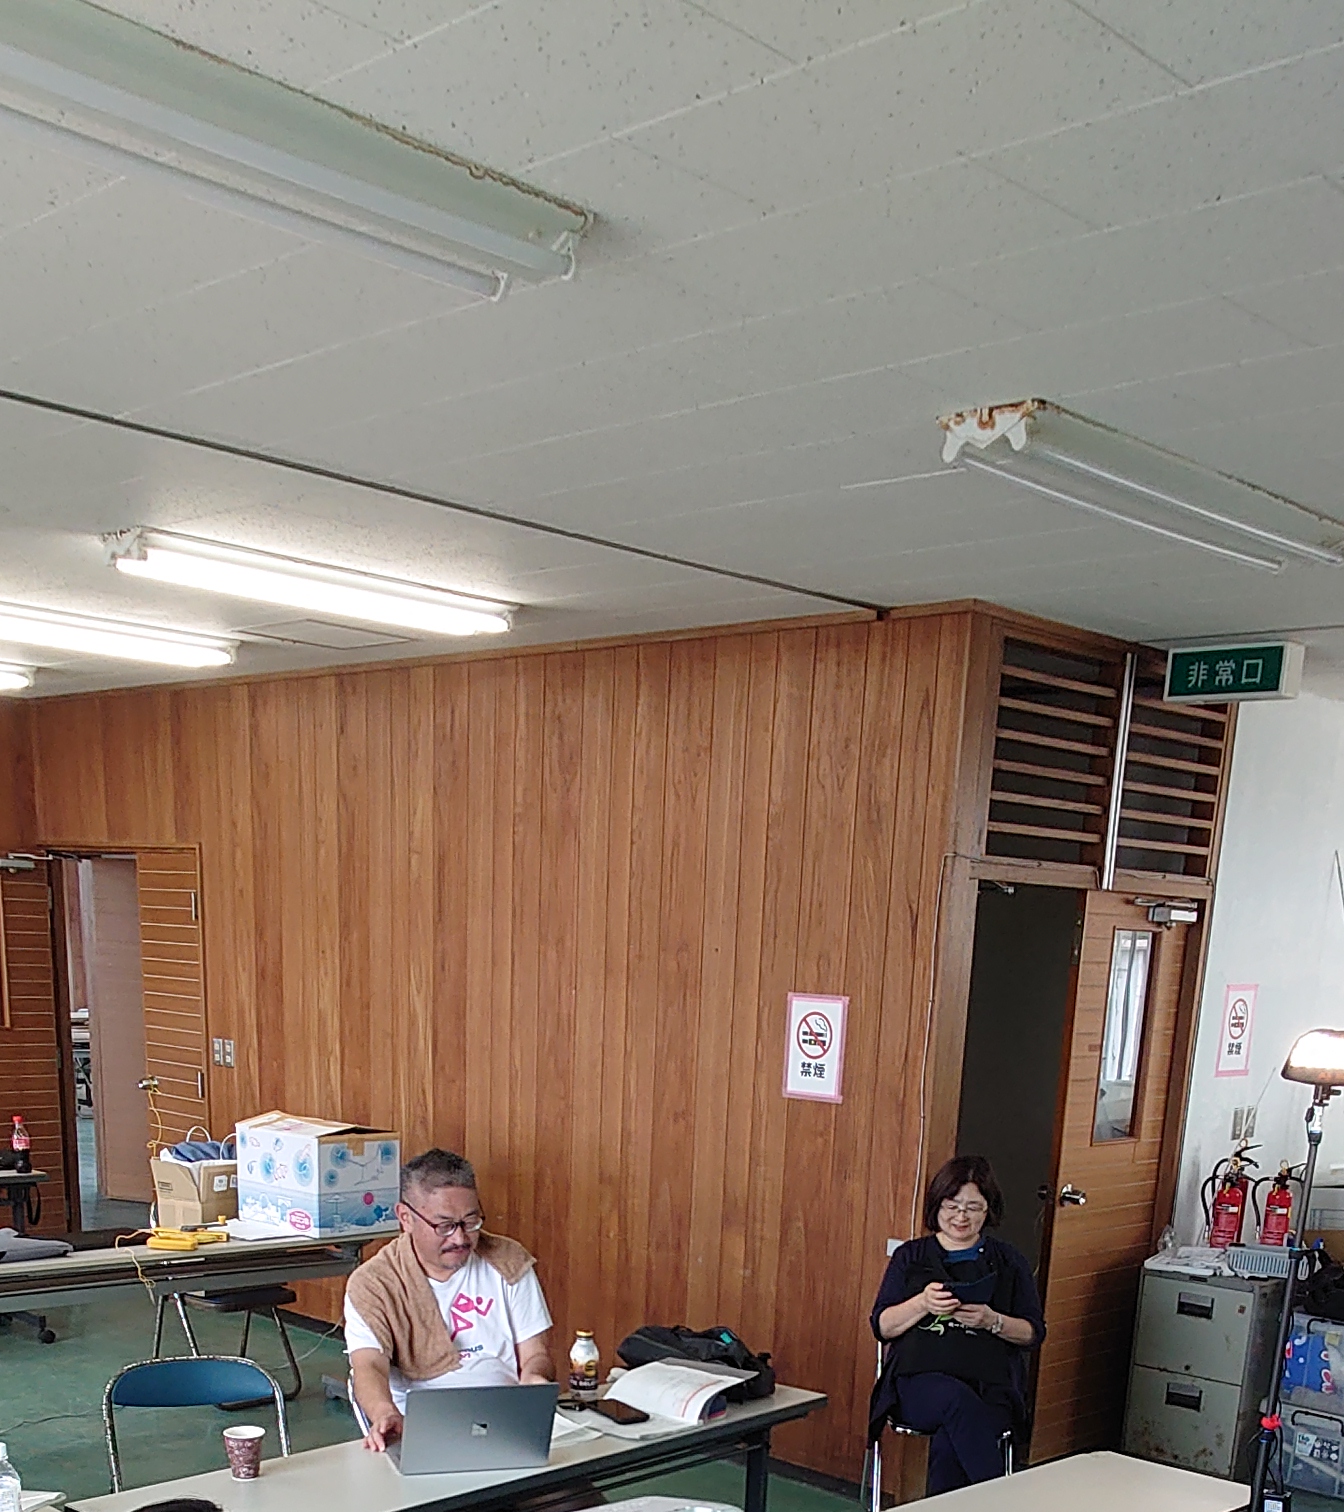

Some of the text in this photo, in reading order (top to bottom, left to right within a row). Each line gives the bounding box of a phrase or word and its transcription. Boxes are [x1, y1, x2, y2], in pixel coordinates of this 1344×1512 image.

[1187, 658, 1263, 689] 非常口
[799, 1061, 827, 1079] 禁煙
